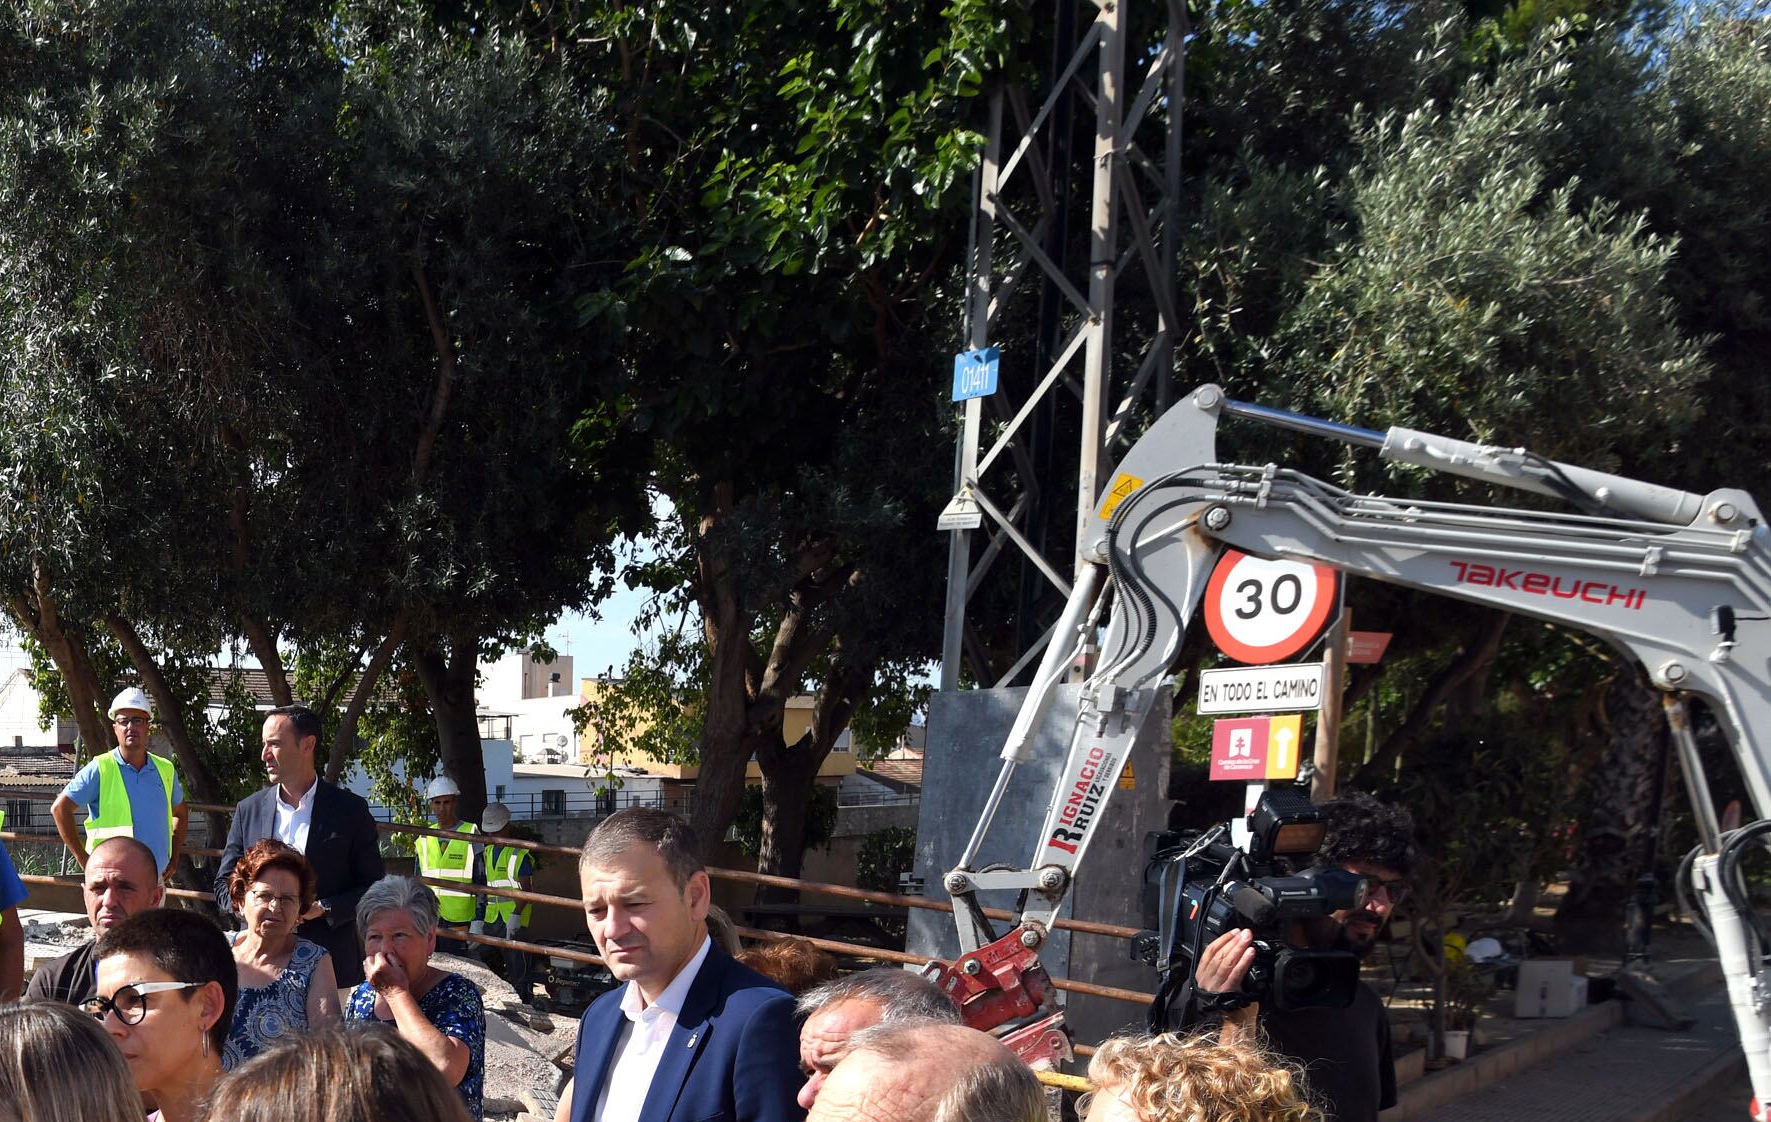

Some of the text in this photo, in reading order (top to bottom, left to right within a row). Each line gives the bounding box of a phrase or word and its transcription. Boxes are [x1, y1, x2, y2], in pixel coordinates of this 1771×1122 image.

[1235, 573, 1302, 620] 30
[1204, 678, 1318, 703] EN TODO EL CAMINO
[1059, 747, 1104, 826] IGNACIO
[1073, 783, 1105, 831] RUIZ
